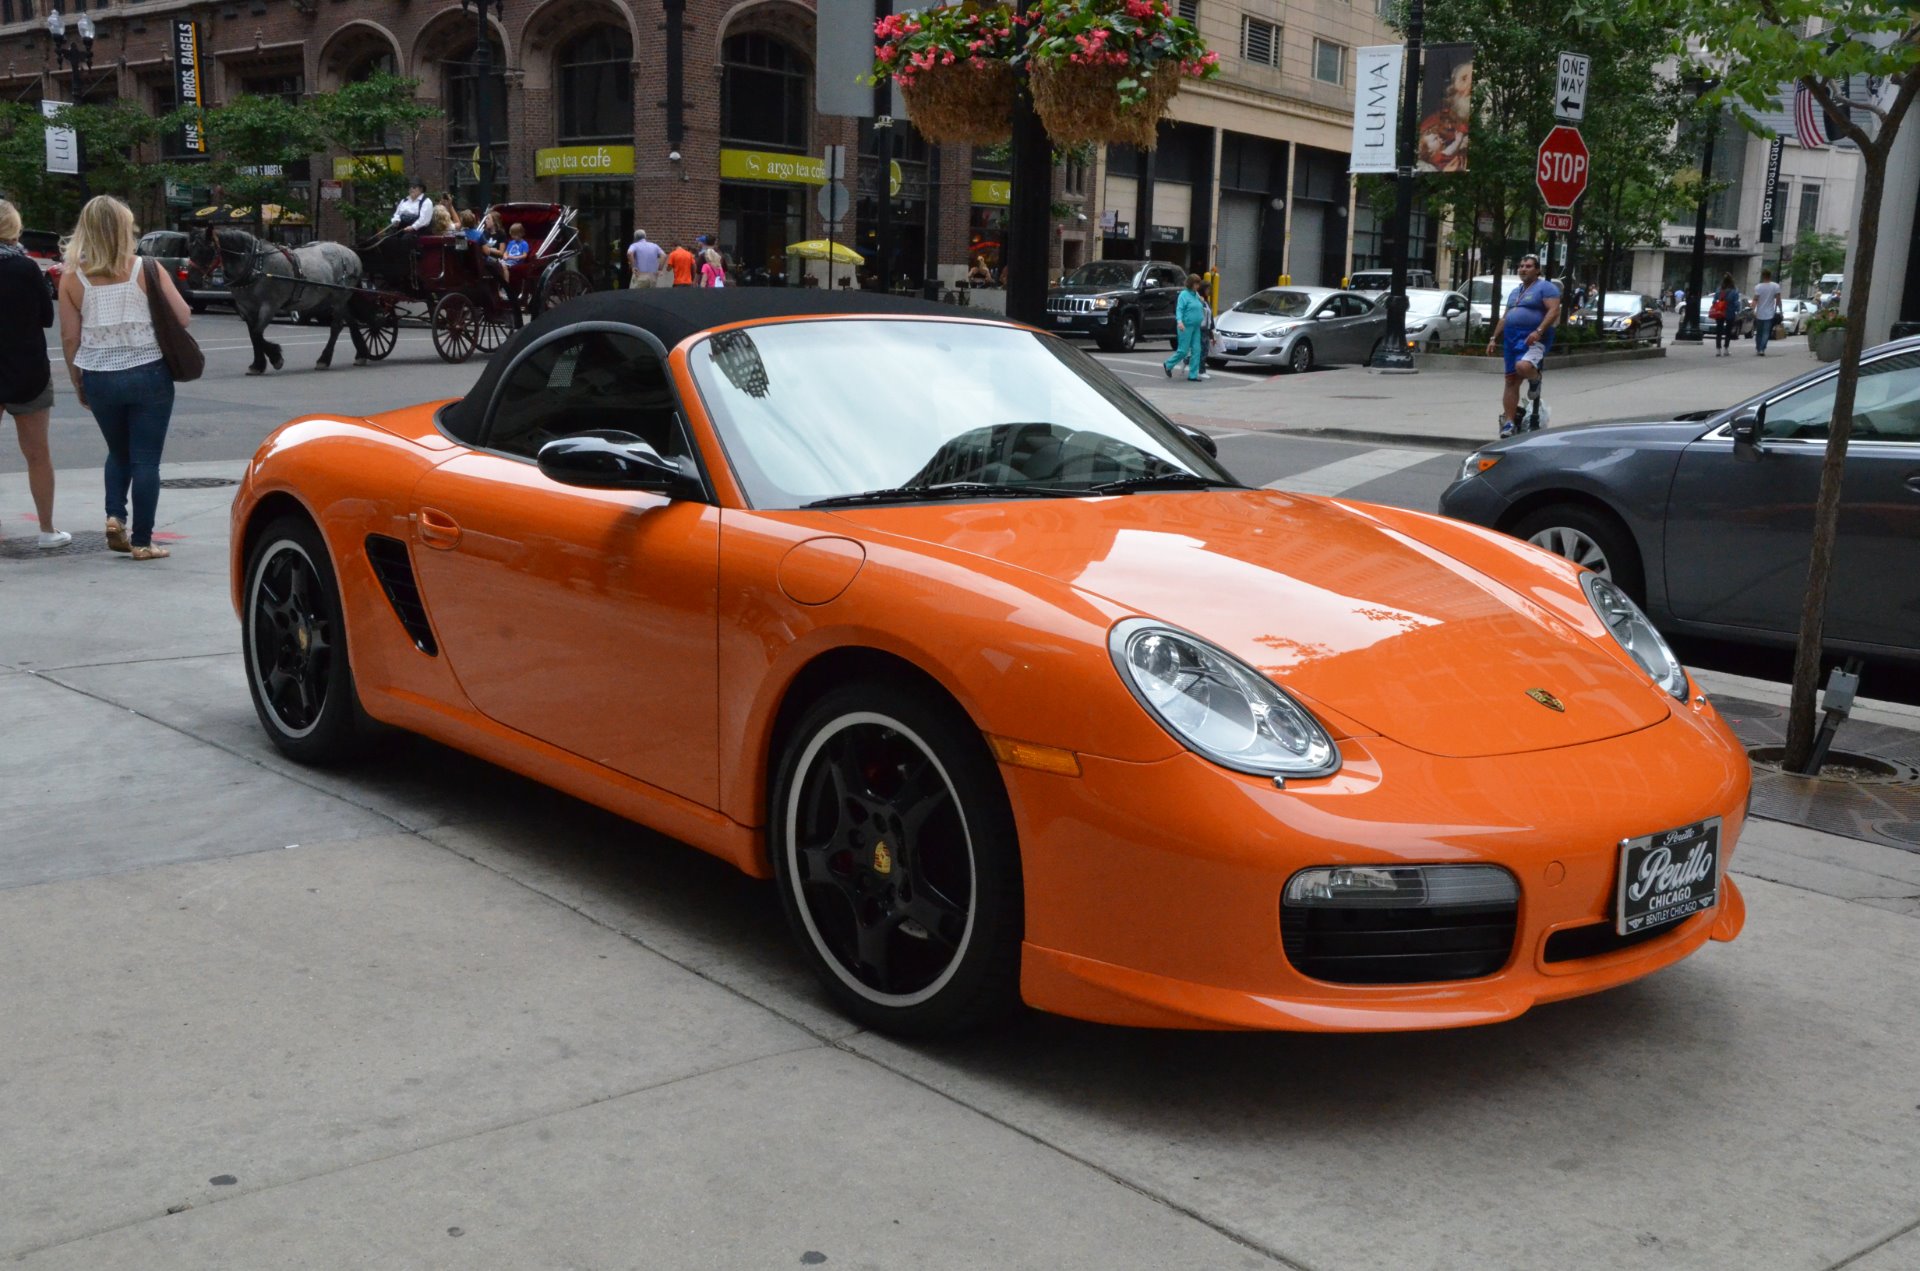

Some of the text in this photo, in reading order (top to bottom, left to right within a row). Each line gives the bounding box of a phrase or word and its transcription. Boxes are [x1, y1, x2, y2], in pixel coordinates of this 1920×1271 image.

[179, 23, 194, 65] BAGELS
[1562, 58, 1586, 77] ONE
[1560, 76, 1585, 94] WAY
[1364, 62, 1390, 147] LUMA
[562, 154, 577, 168] tea
[581, 147, 611, 167] café
[1540, 151, 1586, 183] STOP
[767, 161, 794, 179] argo
[796, 162, 809, 177] tea
[1762, 136, 1781, 224] ORDSTROM rack
[1546, 215, 1570, 228] ALL WAY
[1663, 828, 1695, 846] Perillo
[1629, 841, 1713, 901] Perillo
[1649, 886, 1692, 910] CHICAGO
[1646, 901, 1697, 925] BENTLEY CHICAGO
